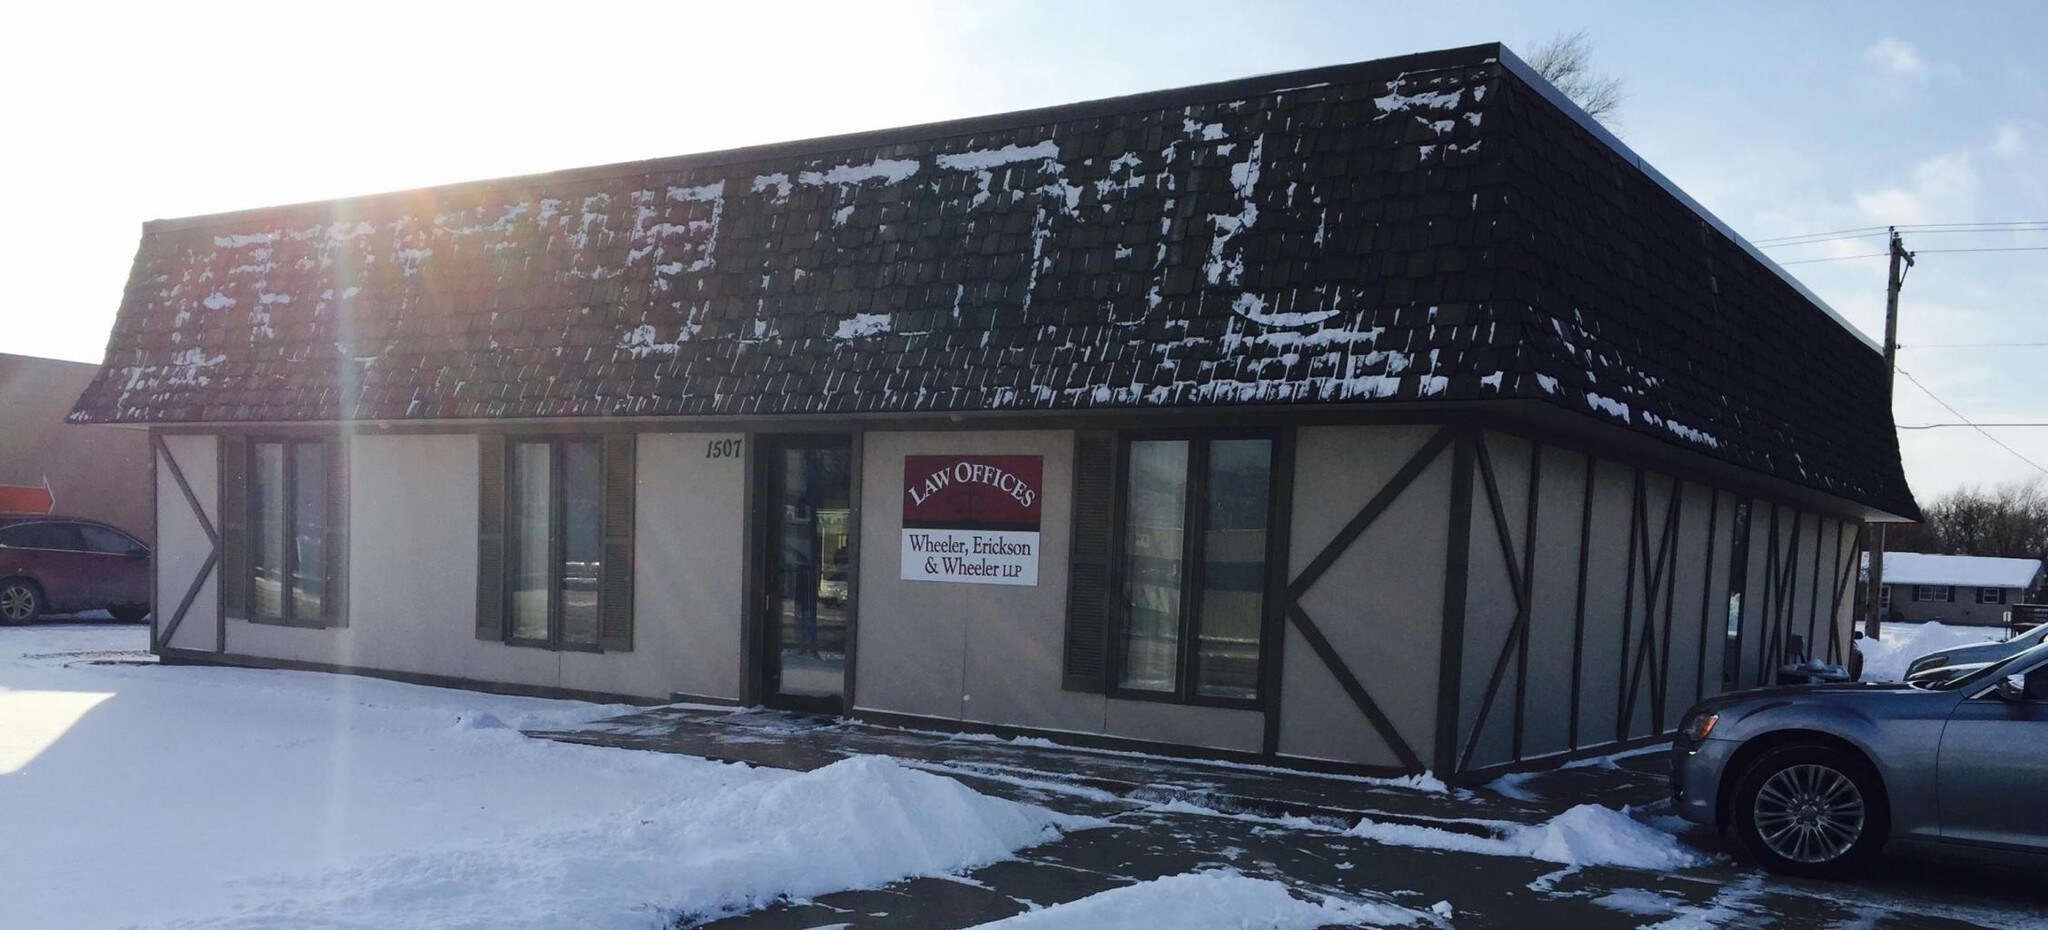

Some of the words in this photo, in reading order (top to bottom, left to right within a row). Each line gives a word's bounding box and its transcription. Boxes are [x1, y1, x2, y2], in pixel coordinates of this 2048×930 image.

[705, 439, 742, 458] 1507
[908, 467, 951, 507] LAW
[954, 462, 1036, 508] OFFICES
[909, 534, 969, 556] Wheeler,
[972, 536, 1031, 556] Erickson
[924, 556, 939, 574] &
[941, 556, 1000, 577] Wheeler
[1002, 564, 1022, 578] LLP
